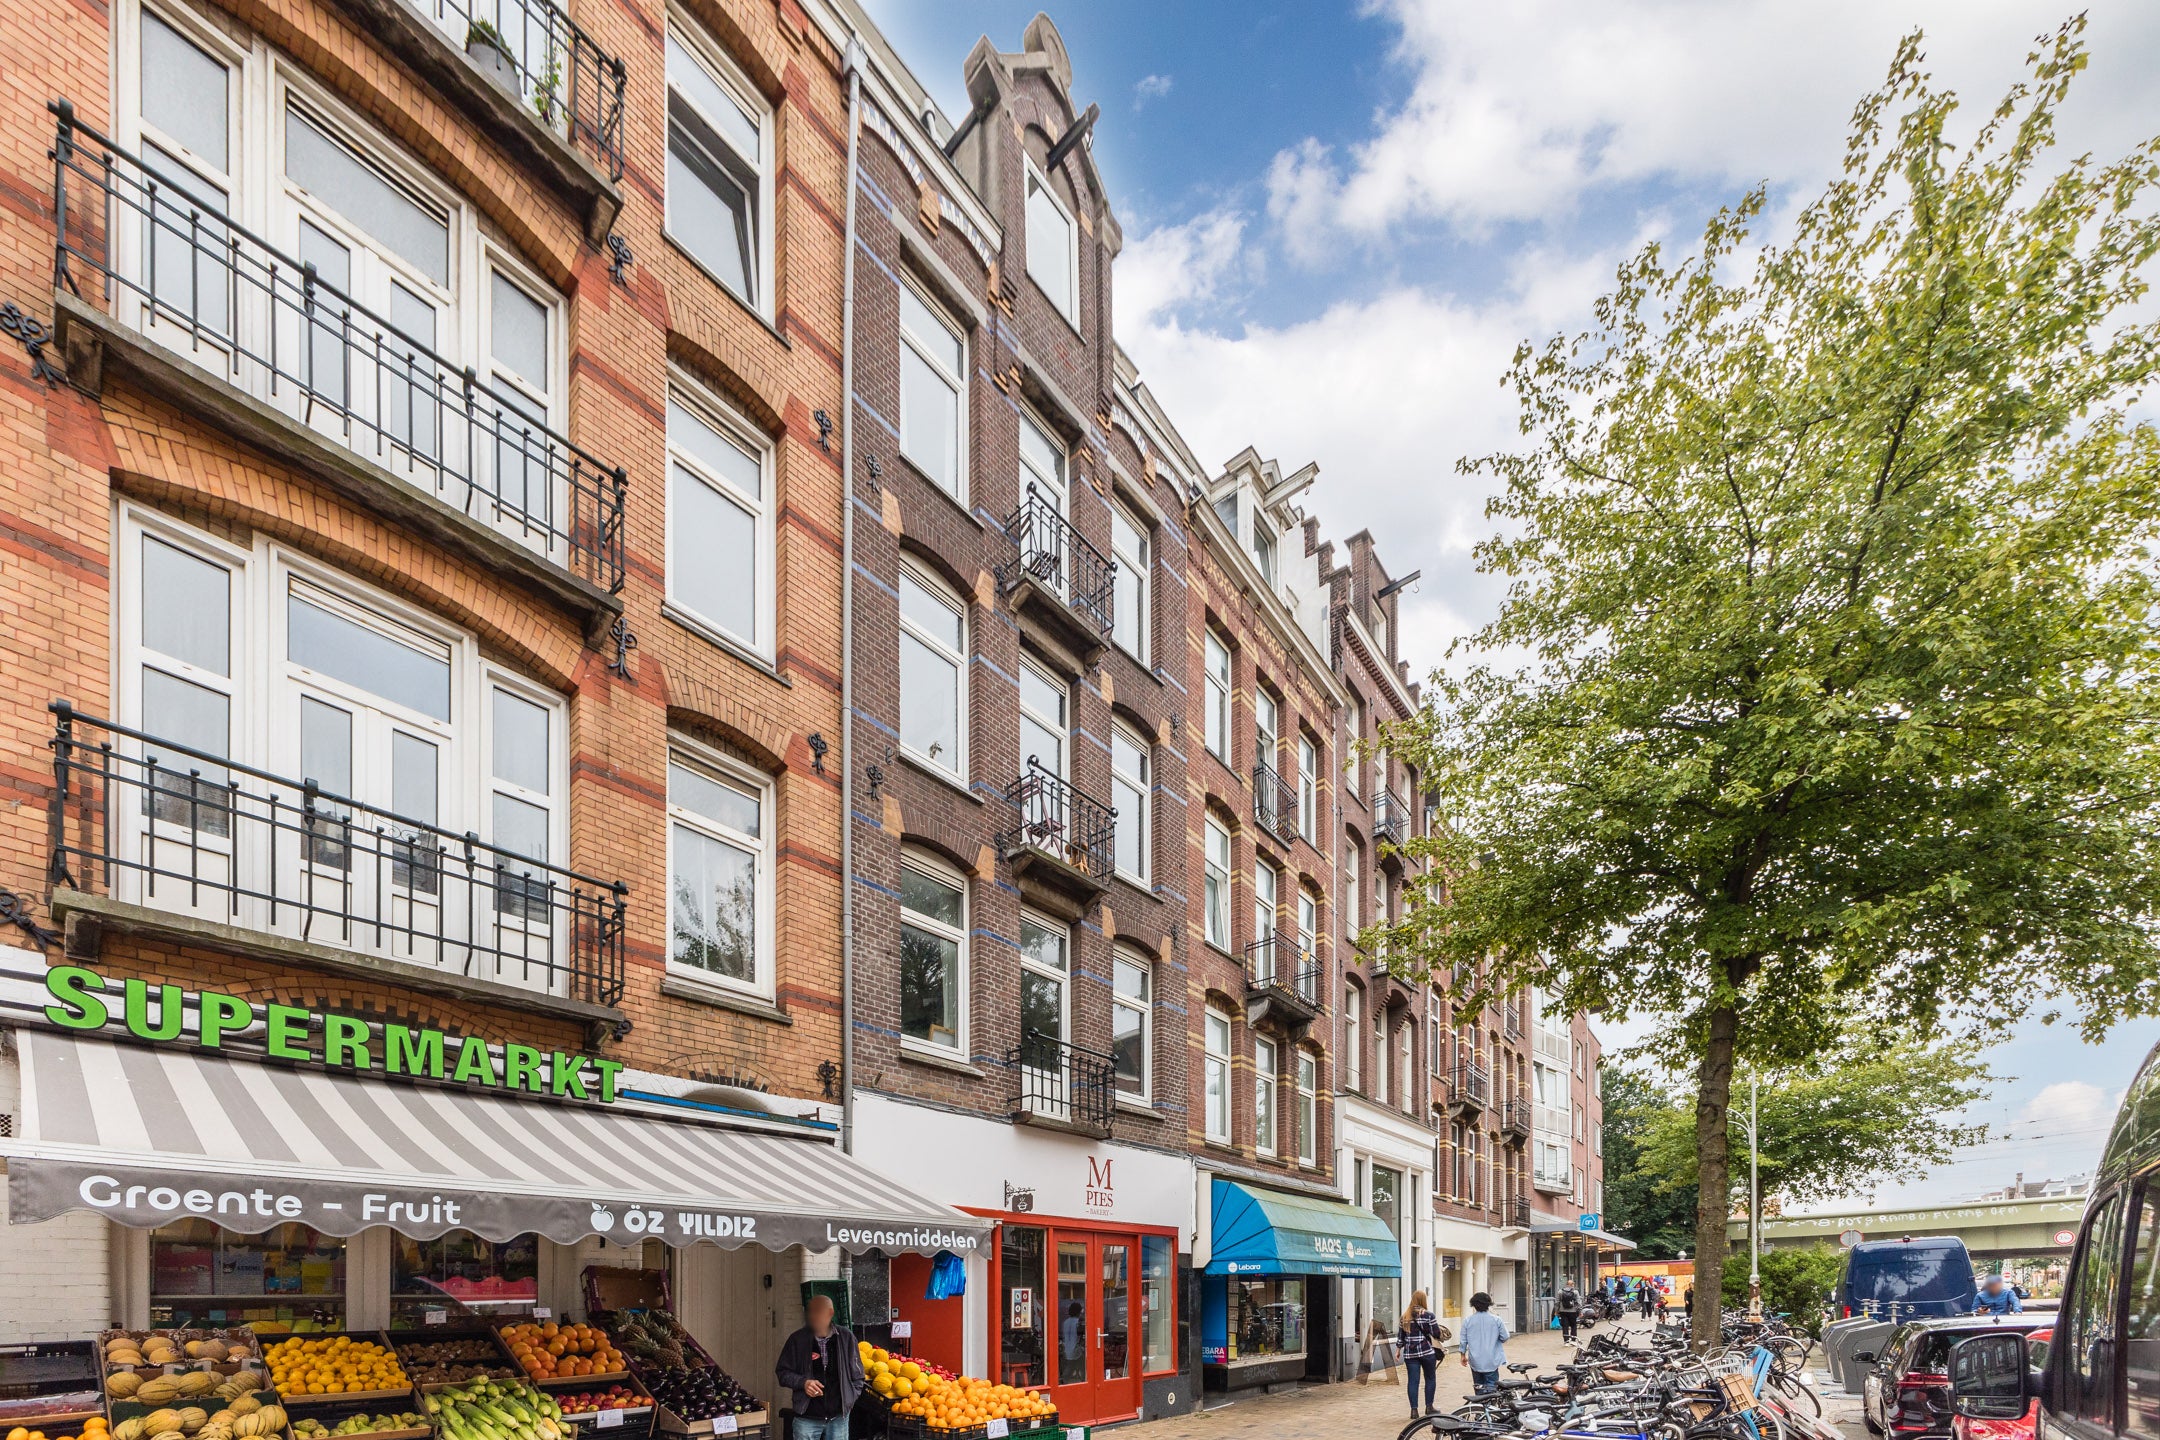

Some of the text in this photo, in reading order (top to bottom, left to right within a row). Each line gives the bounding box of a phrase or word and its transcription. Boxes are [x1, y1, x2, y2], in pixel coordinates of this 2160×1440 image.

[43, 965, 624, 1103] SUPERMARKT
[1086, 1155, 1114, 1190] M
[79, 1175, 303, 1218] Groente
[362, 1194, 461, 1225] Fruit
[1086, 1190, 1114, 1208] PIES
[623, 1204, 756, 1238] ÖZ YILDIZ
[826, 1222, 978, 1250] Levensmiddelen
[1314, 1236, 1341, 1253] HAQ'S
[1238, 1263, 1261, 1271] Lebara
[1202, 1346, 1225, 1355] EBARA
